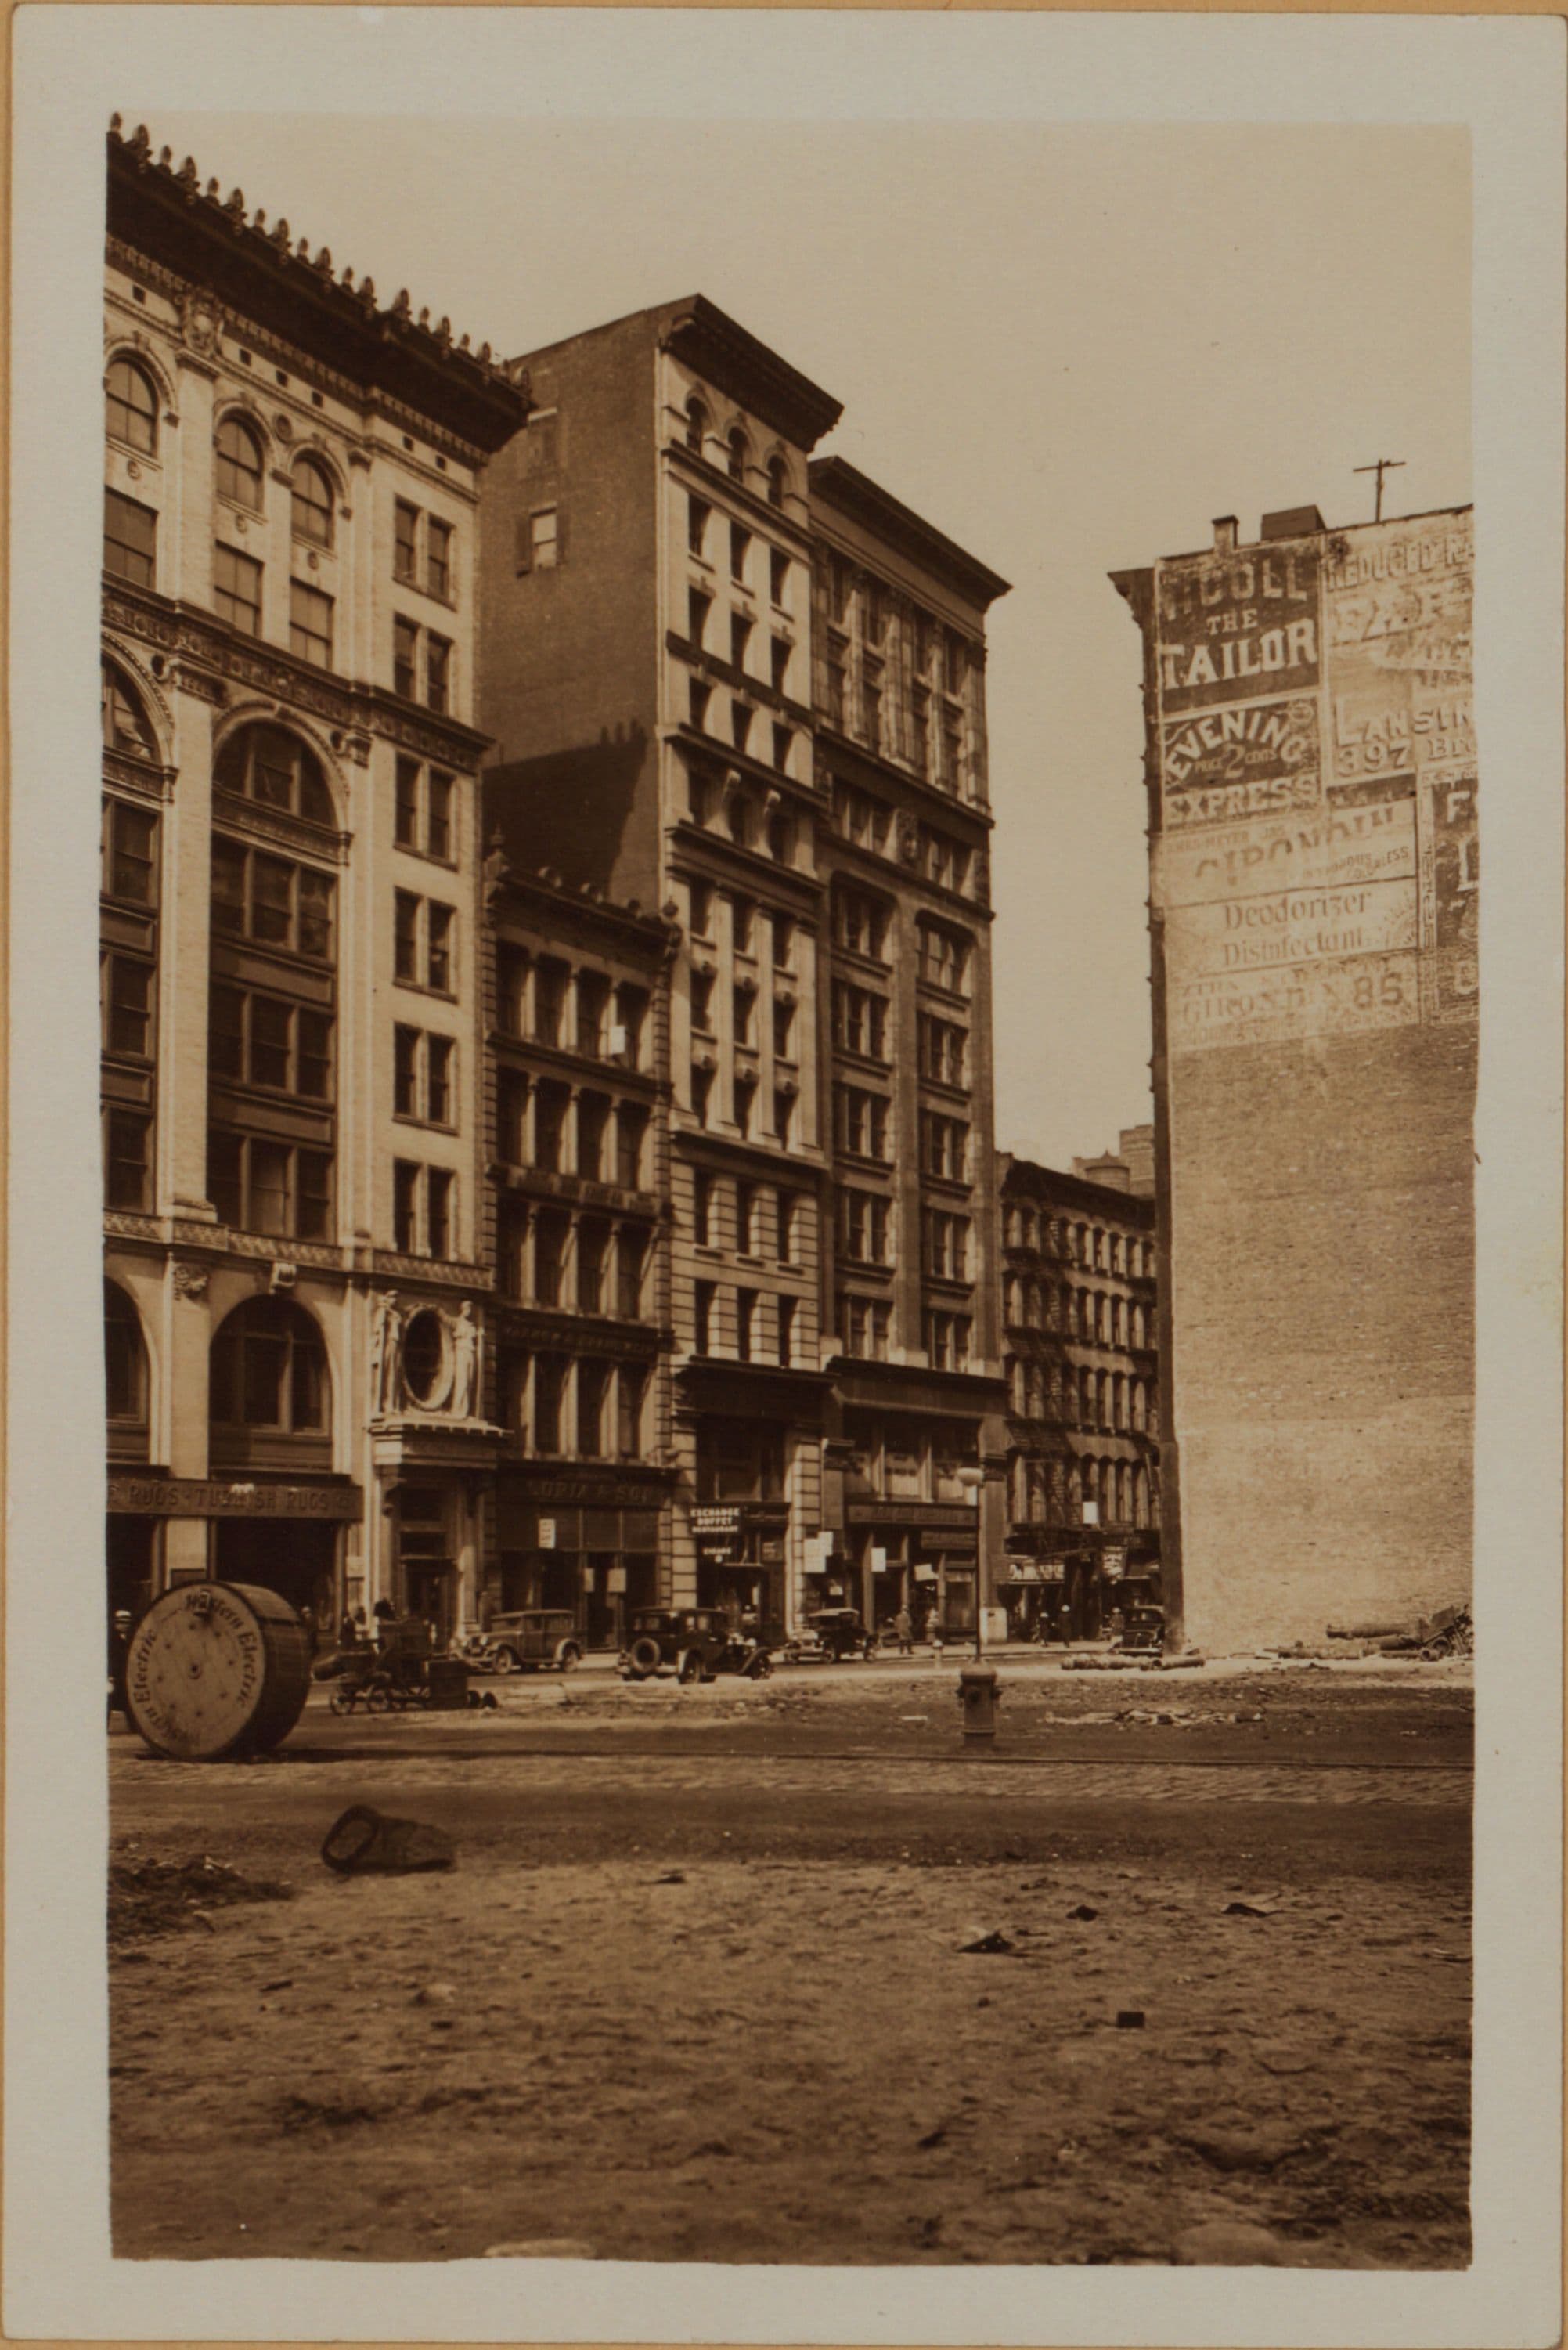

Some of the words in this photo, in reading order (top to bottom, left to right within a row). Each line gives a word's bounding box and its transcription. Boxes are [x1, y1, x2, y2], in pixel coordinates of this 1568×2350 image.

[1206, 608, 1259, 636] THE
[1153, 618, 1317, 689] TAILOR
[1165, 709, 1307, 782] EVENING
[1224, 743, 1246, 779] 2
[1338, 739, 1412, 778] 397
[1166, 774, 1317, 823] EXPRESS
[1223, 890, 1372, 930] Deodorizer
[1222, 927, 1364, 966] Disinfectant
[1353, 972, 1404, 1010] 85
[129, 1484, 178, 1506] RUGS
[287, 1491, 328, 1511] RUGS
[133, 1627, 159, 1704] Electric
[236, 1631, 258, 1709] Electric
